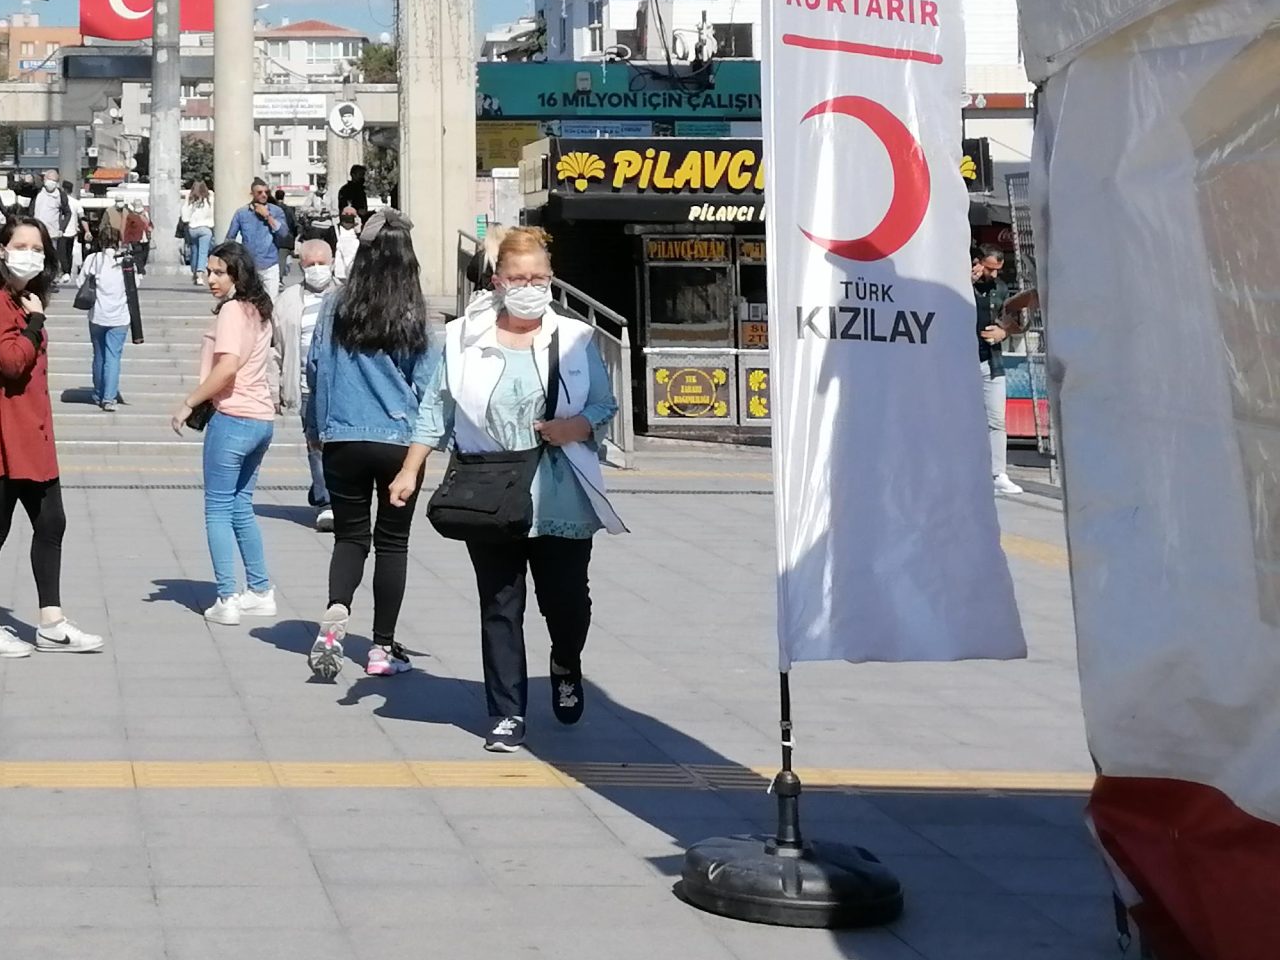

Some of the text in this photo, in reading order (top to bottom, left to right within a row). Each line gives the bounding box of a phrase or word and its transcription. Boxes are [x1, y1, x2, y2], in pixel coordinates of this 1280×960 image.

[537, 91, 558, 108] 16
[839, 276, 895, 303] TÜRK
[796, 305, 936, 345] KIZILAY
